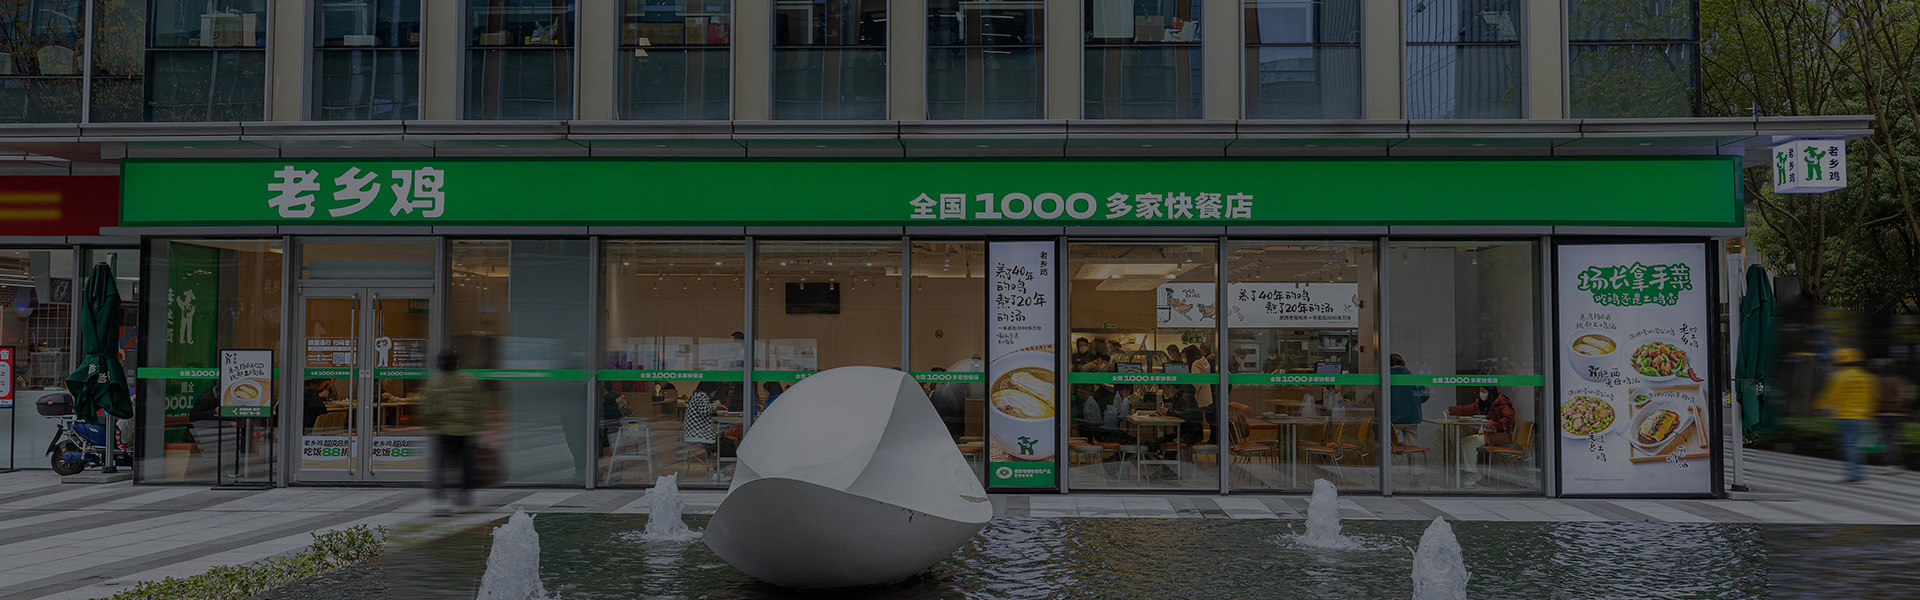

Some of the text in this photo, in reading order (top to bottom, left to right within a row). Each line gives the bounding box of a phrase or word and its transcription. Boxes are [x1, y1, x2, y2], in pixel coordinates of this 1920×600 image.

[1828, 146, 1840, 181] 老乡鸡
[267, 165, 445, 218] 老乡鸡
[996, 262, 1034, 281] 养了40年
[1040, 251, 1048, 276] 老乡鸡
[1579, 264, 1692, 291] 场长拿手菜
[996, 278, 1027, 294] 的鸡
[996, 292, 1046, 309] 熬了20年
[1239, 288, 1310, 302] 养了40年的鸡
[1594, 292, 1678, 305] 吃鸡还是土鸡香
[997, 309, 1026, 322] 的汤
[1265, 301, 1334, 314] 熬了20年的汤
[373, 448, 411, 457] 吃饭88
